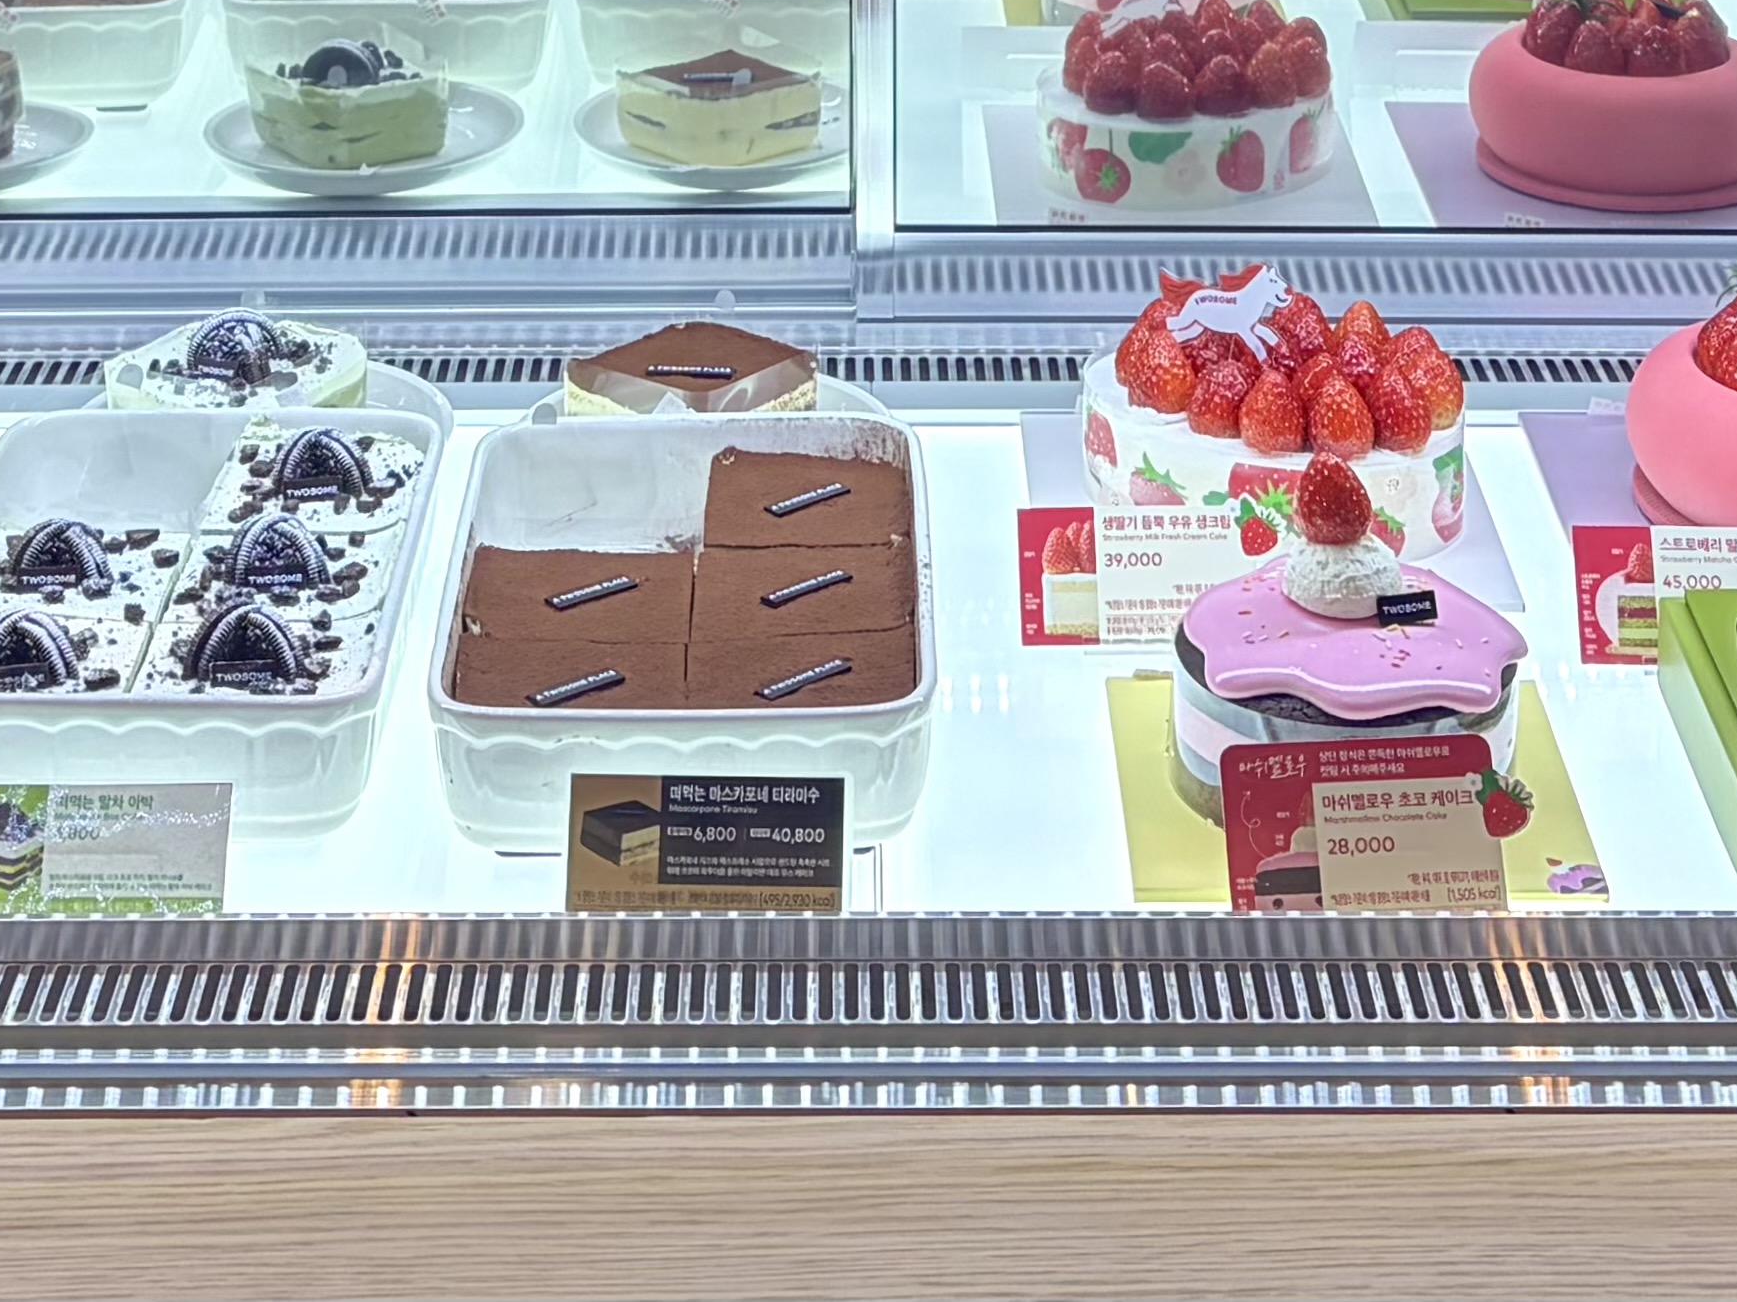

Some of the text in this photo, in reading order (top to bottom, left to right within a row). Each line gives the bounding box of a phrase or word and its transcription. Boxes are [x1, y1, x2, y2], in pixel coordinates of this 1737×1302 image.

[1101, 514, 1232, 531] 생딸기 듬뿍 우유 생크림
[1659, 537, 1723, 553] 스트로베리
[1104, 552, 1163, 569] 39,000
[1662, 574, 1723, 590] 45,000
[669, 784, 821, 804] 떠먹는 마스카포네 티라미수
[1321, 789, 1474, 811] 마쉬멜로우 초코 케이크
[722, 804, 759, 814] Tiramisu
[693, 826, 826, 845] 6,800 40,800
[1326, 835, 1396, 857] 28,000
